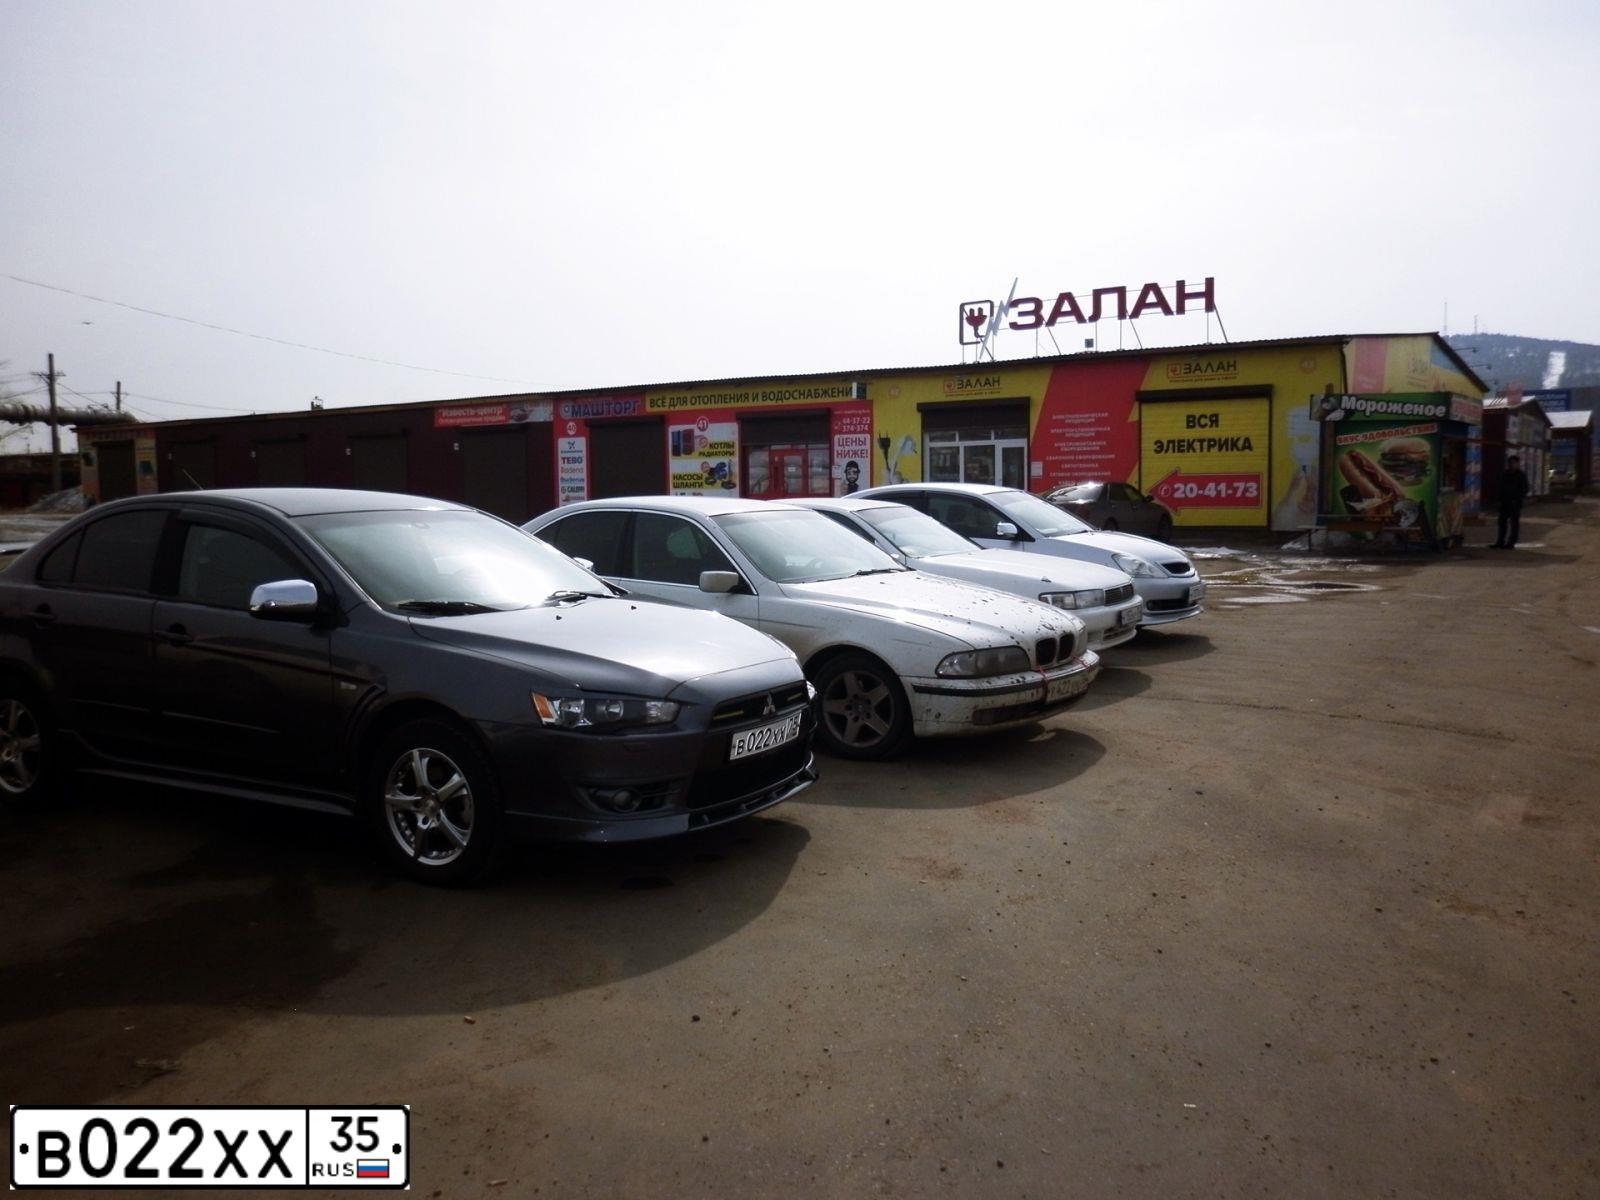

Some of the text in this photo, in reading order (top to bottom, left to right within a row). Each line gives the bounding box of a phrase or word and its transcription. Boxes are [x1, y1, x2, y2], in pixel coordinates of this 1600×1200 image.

[1008, 277, 1215, 330] ЗАЛАН
[1183, 360, 1238, 375] ЗАЛАН
[956, 376, 1001, 390] ЗАЛАН
[668, 396, 688, 409] ДЛЯ
[689, 392, 750, 406] ОТОПЛЕНИЯ
[751, 391, 759, 402] И
[761, 386, 854, 403] ВОДОСНАБЖЕНИ
[1341, 395, 1447, 418] Мороженое
[1185, 413, 1220, 430] ВСЯ
[708, 441, 735, 449] КОТЛЫ
[837, 436, 867, 447] ЦЕНЫ
[1153, 436, 1254, 454] ЭЛЕКТРИКА
[835, 448, 869, 459] НИЖЕ!
[673, 481, 704, 489] ШЛАНГИ
[1173, 481, 1258, 498] 20-41-73
